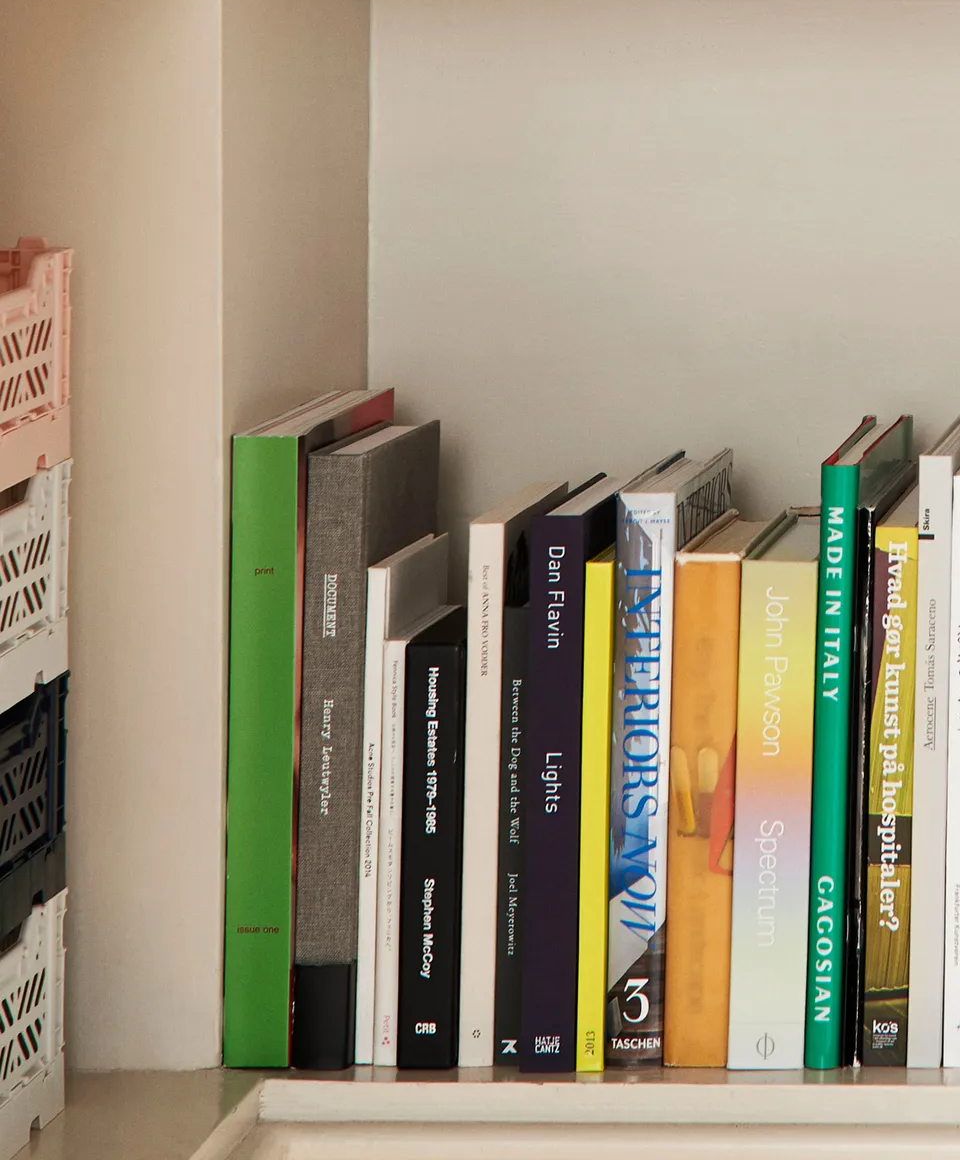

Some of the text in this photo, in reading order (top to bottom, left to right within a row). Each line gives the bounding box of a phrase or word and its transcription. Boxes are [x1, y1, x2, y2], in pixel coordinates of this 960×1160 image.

[255, 567, 274, 576] print
[885, 541, 908, 610] Hvad
[879, 614, 904, 659] gør
[925, 599, 936, 651] Saraceno
[319, 573, 338, 815] DOCUMENT Henry Leutwyler
[426, 667, 439, 717] Housing
[541, 547, 565, 813] Dan Flavin Lights
[924, 655, 935, 692] Tomás
[882, 661, 904, 739] kunst
[924, 697, 936, 750] Aerocene
[427, 721, 438, 767] Estates
[753, 585, 789, 947] John Pawson Spectrum
[813, 505, 845, 1024] MADE IN ITALY GAGOSIAN
[877, 742, 905, 776] på
[506, 680, 522, 955] Between the Dog and the Wolf Joel Meyerowitz
[620, 566, 662, 1023] INTERIORS NOW 3
[365, 820, 373, 858] Collection
[877, 779, 903, 932] hospitaler?
[422, 879, 435, 930] Stephen
[420, 934, 433, 978] McCoy
[415, 1022, 436, 1034] CRB
[535, 1036, 560, 1045] HATJE
[535, 1045, 559, 1053] CANTZ
[585, 1031, 595, 1055] 2013
[612, 1037, 660, 1051] TASCHEN
